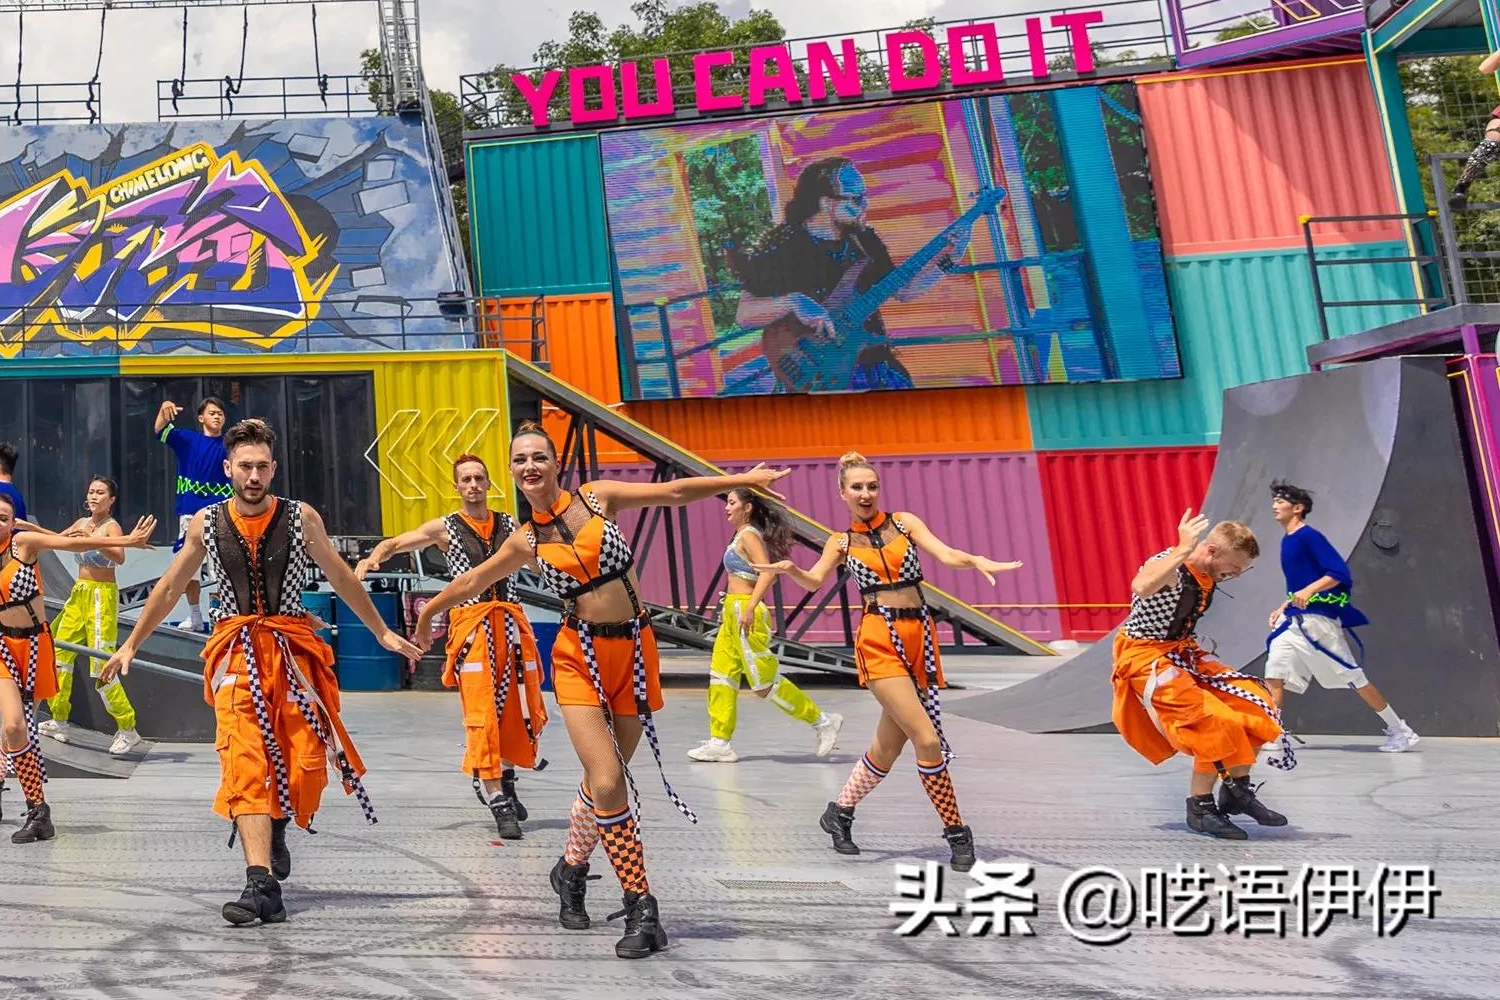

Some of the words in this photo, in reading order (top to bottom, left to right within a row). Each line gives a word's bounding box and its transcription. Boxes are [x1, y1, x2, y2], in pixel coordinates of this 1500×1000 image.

[513, 59, 673, 125] YOU
[694, 41, 860, 110] CAN
[887, 24, 1003, 90] DO
[1027, 12, 1101, 76] IT
[109, 148, 211, 204] CHIMELONG
